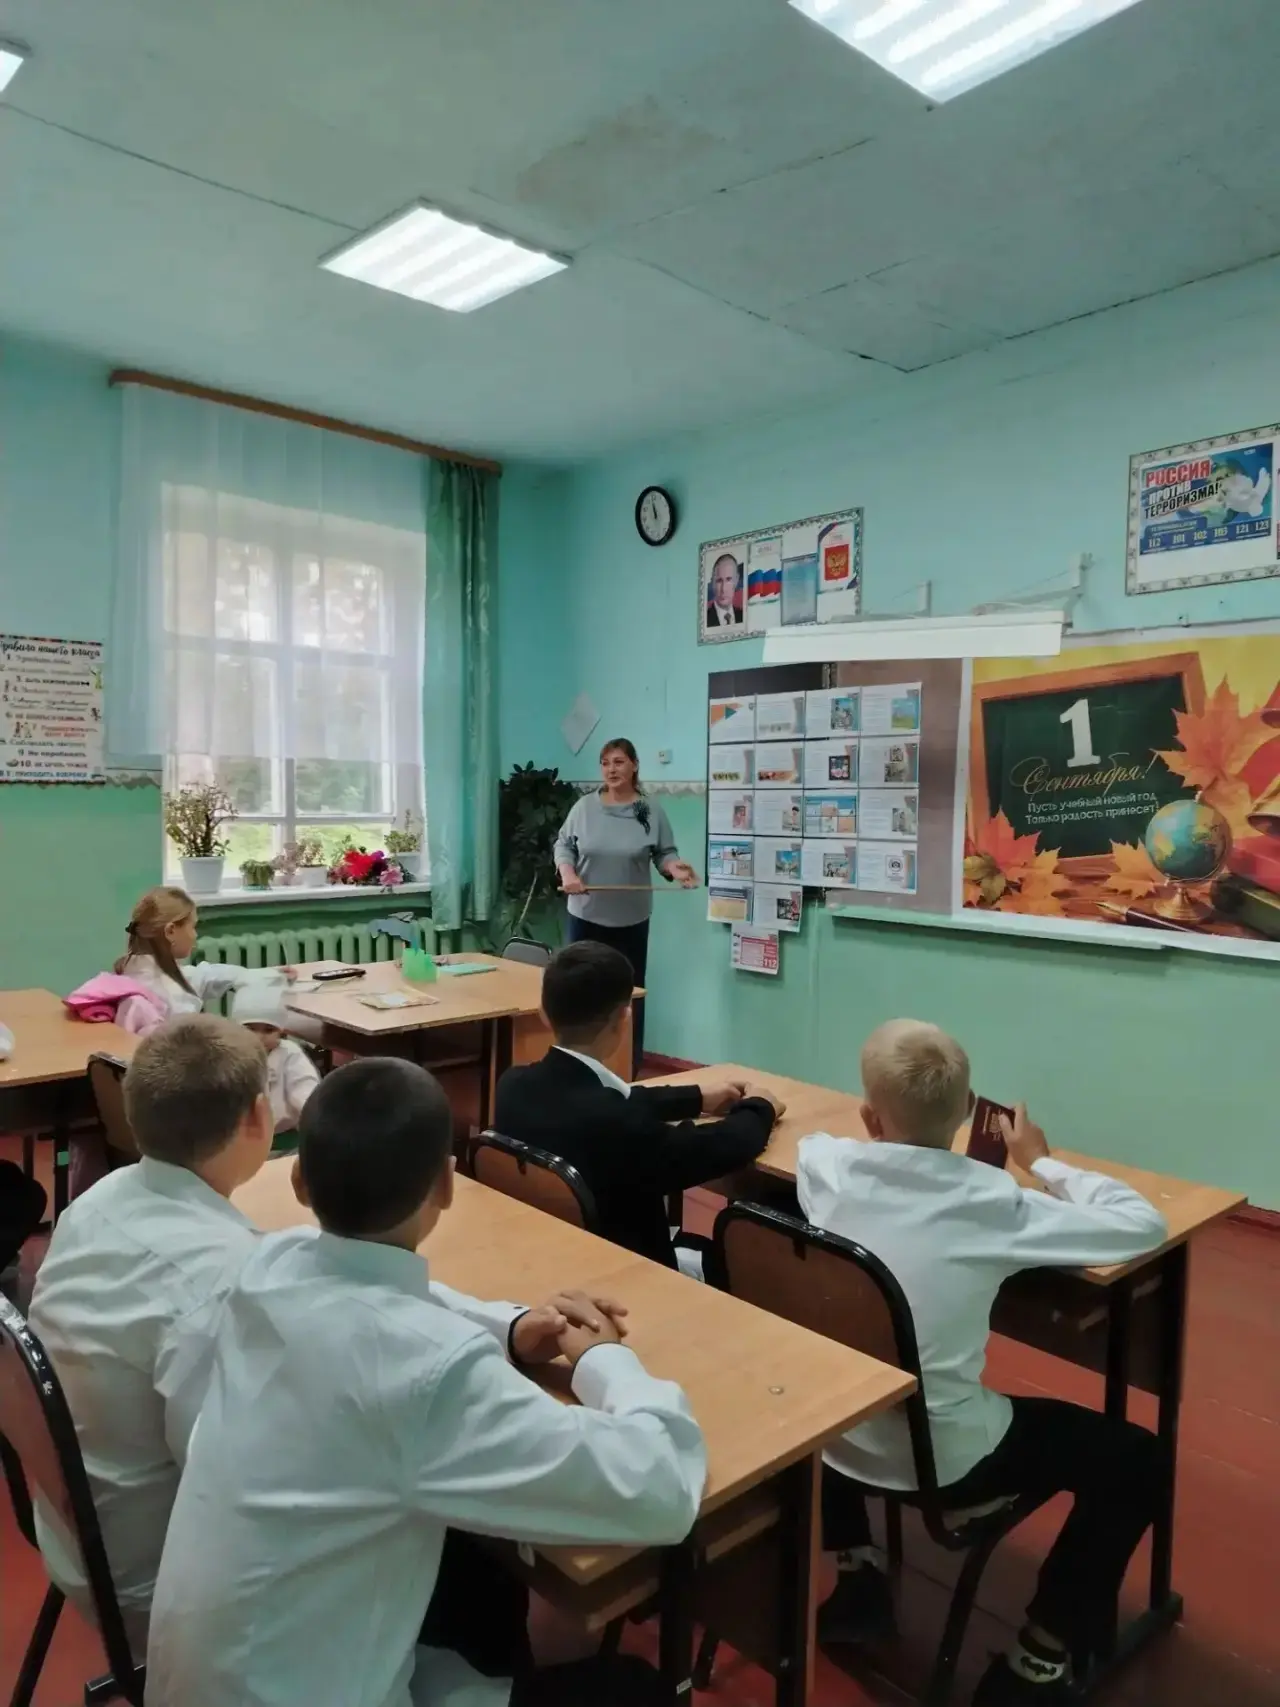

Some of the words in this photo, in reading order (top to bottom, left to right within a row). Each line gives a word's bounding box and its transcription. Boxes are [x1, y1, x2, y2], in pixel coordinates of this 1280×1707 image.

[1145, 459, 1211, 488] РОССИЯ
[1144, 481, 1221, 519] ТЕРРОРИЗМА!
[1149, 480, 1192, 506] ПРОТИВ
[1148, 537, 1161, 548] 112
[1255, 521, 1269, 531] 123
[1059, 698, 1101, 768] 1
[1009, 748, 1159, 801] Сентября!
[1027, 802, 1058, 814] Пусть
[1059, 796, 1102, 811] учебный
[1103, 792, 1137, 805] новый
[1138, 792, 1158, 802] год
[1025, 813, 1060, 825] Только
[1061, 809, 1103, 823] радость
[763, 958, 777, 969] 112
